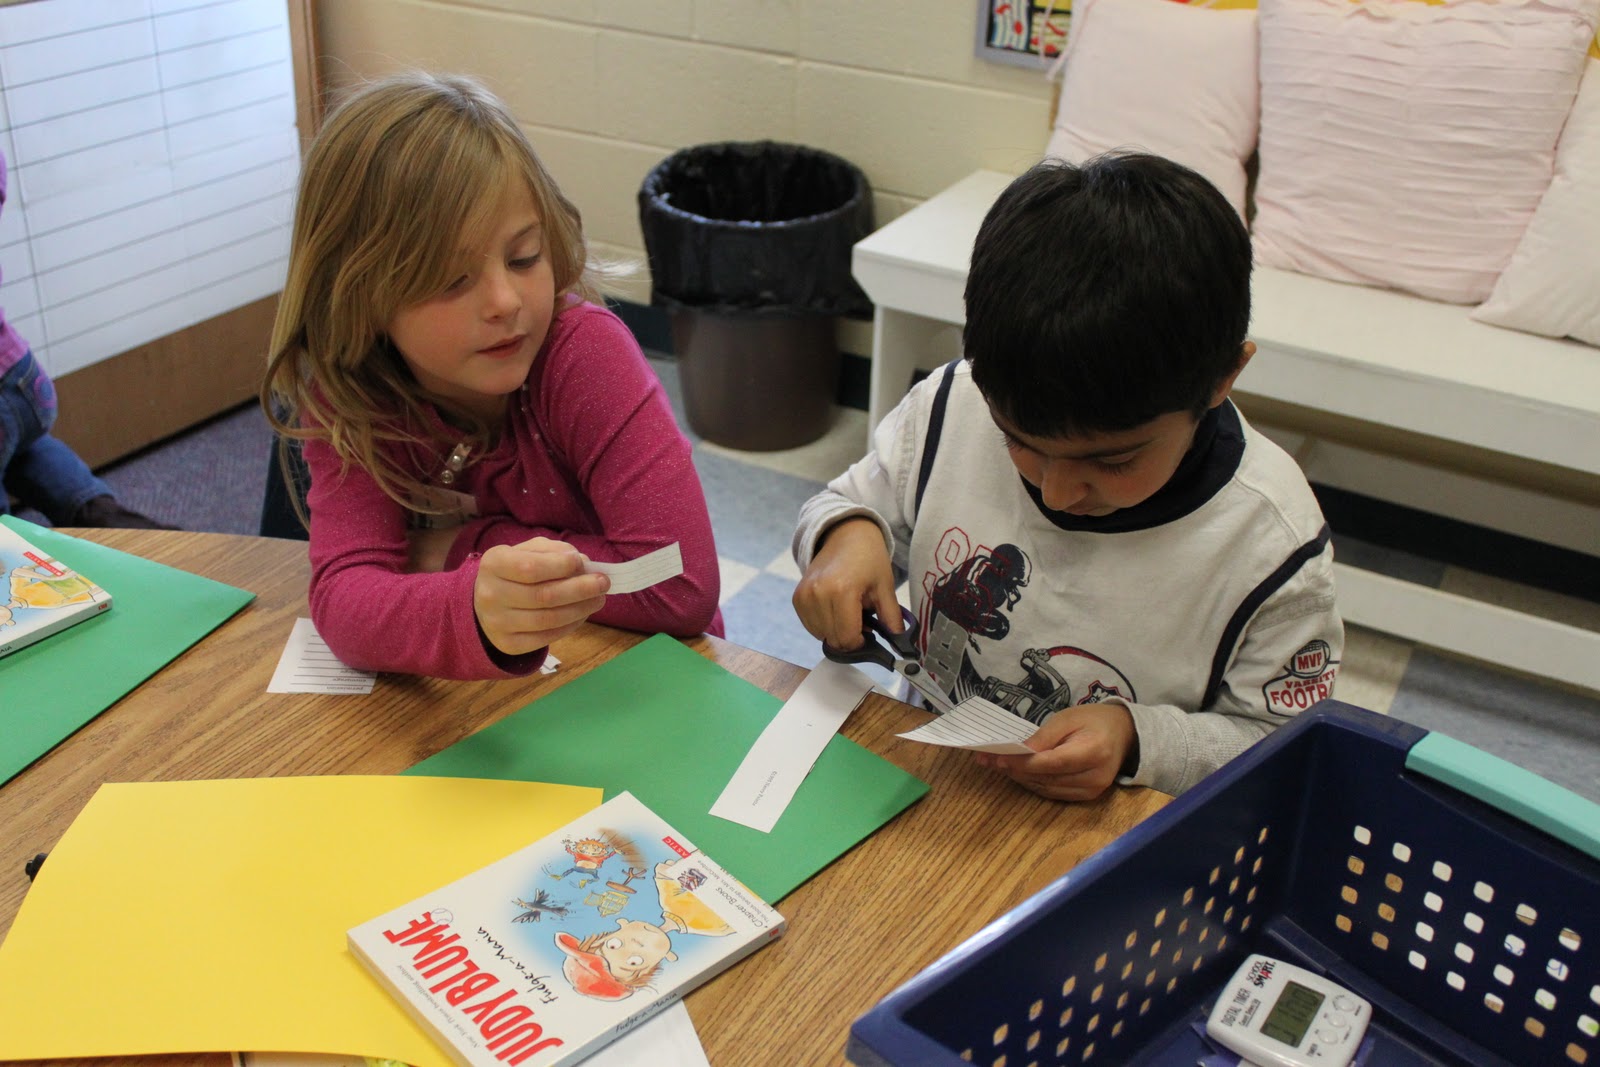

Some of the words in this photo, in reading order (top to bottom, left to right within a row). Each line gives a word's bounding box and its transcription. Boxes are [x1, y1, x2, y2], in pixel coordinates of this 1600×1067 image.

[1297, 652, 1322, 670] MVP
[1285, 669, 1335, 688] VARSITY
[1270, 681, 1333, 709] FOOTB
[716, 888, 737, 904] Books
[736, 902, 762, 927] Chapter
[382, 911, 500, 1007] BLUME
[476, 926, 559, 1004] Fudge-a-Mania
[1246, 960, 1264, 981] SCHOOL
[398, 965, 414, 980] author
[1254, 961, 1275, 988] SMART
[1221, 1006, 1242, 1026] DIGITAL
[1233, 988, 1251, 1006] TIMER
[462, 989, 564, 1067] JUDY
